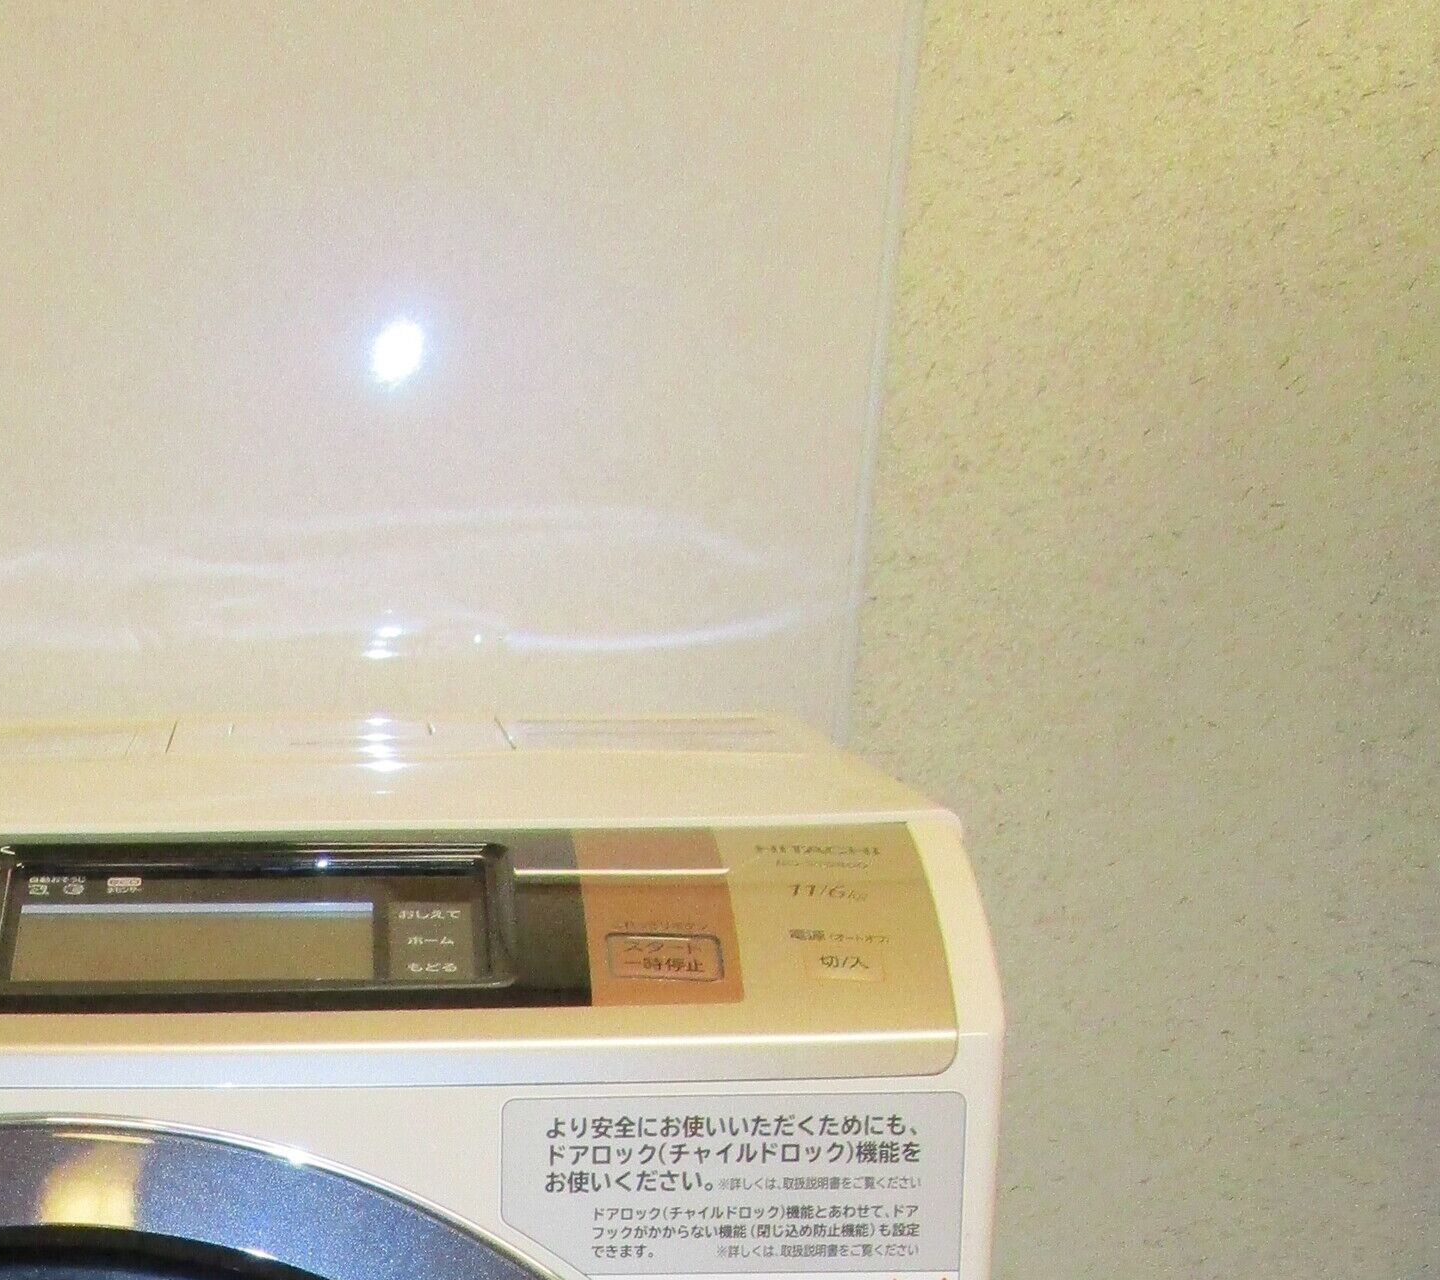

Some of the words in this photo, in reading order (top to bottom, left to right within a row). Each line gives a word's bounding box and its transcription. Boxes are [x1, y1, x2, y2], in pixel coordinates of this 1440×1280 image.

[546, 1114, 919, 1140] より安全にお使いいただくためにも、
